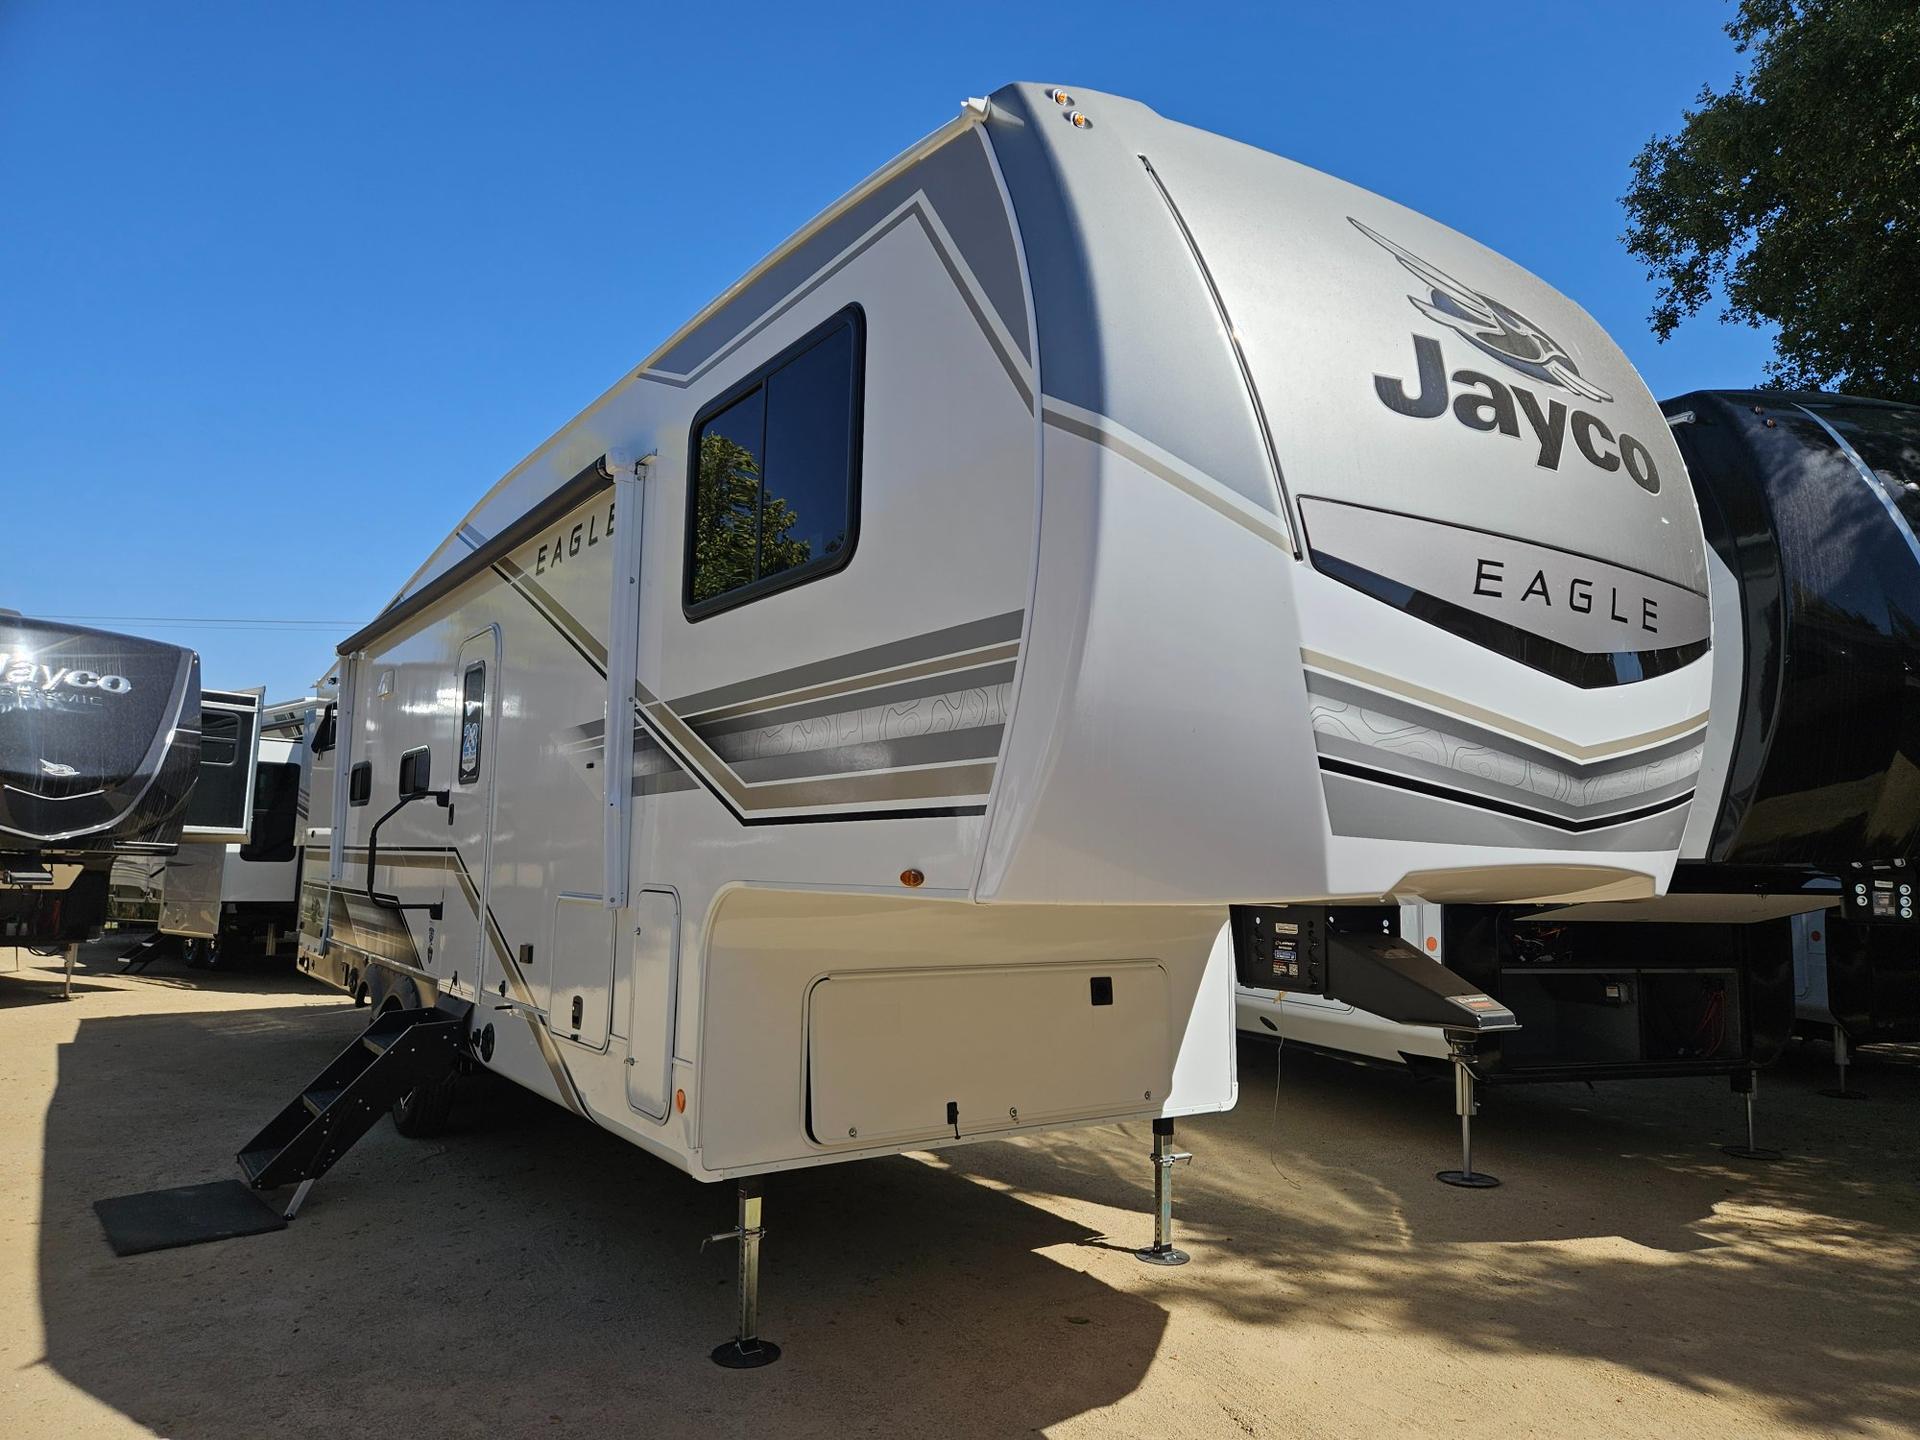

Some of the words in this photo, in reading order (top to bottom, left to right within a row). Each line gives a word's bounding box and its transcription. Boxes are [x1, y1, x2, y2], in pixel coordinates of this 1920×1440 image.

[1373, 334, 1661, 495] Jayco
[535, 502, 616, 576] EAGLE
[1473, 558, 1659, 633] EAGLE
